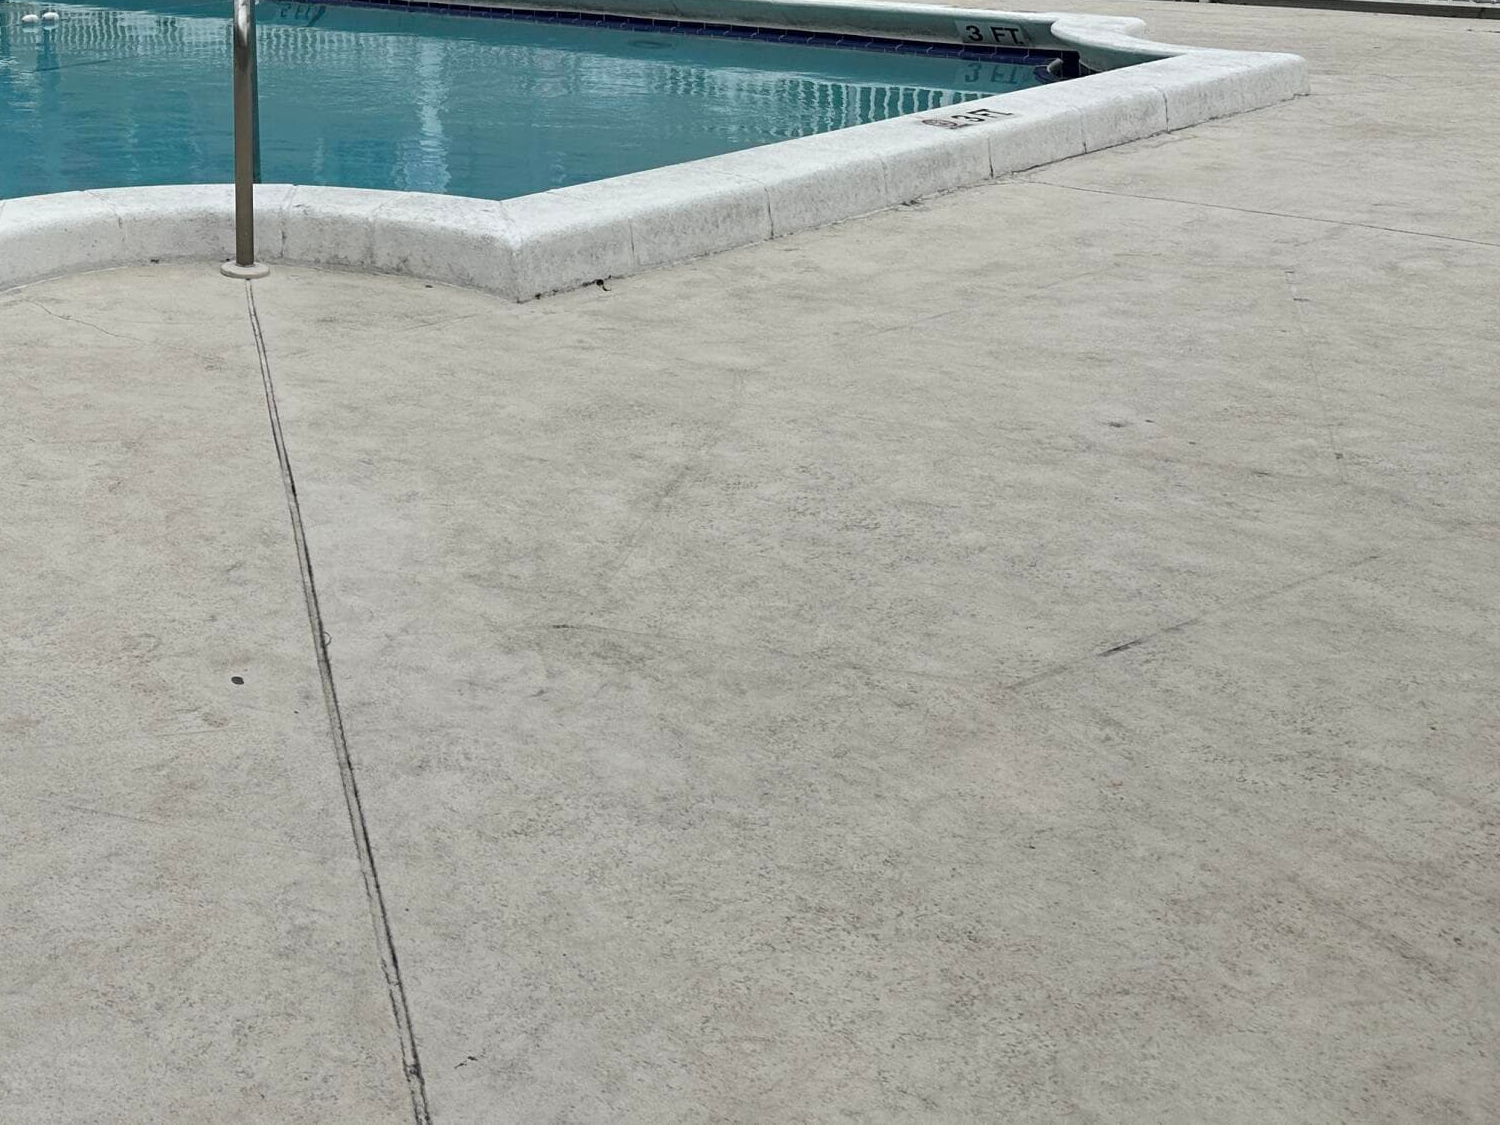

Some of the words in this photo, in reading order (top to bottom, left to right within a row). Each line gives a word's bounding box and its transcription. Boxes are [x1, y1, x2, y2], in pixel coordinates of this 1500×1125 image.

[966, 25, 983, 42] 3
[990, 26, 1024, 45] FT.
[950, 114, 986, 123] 3
